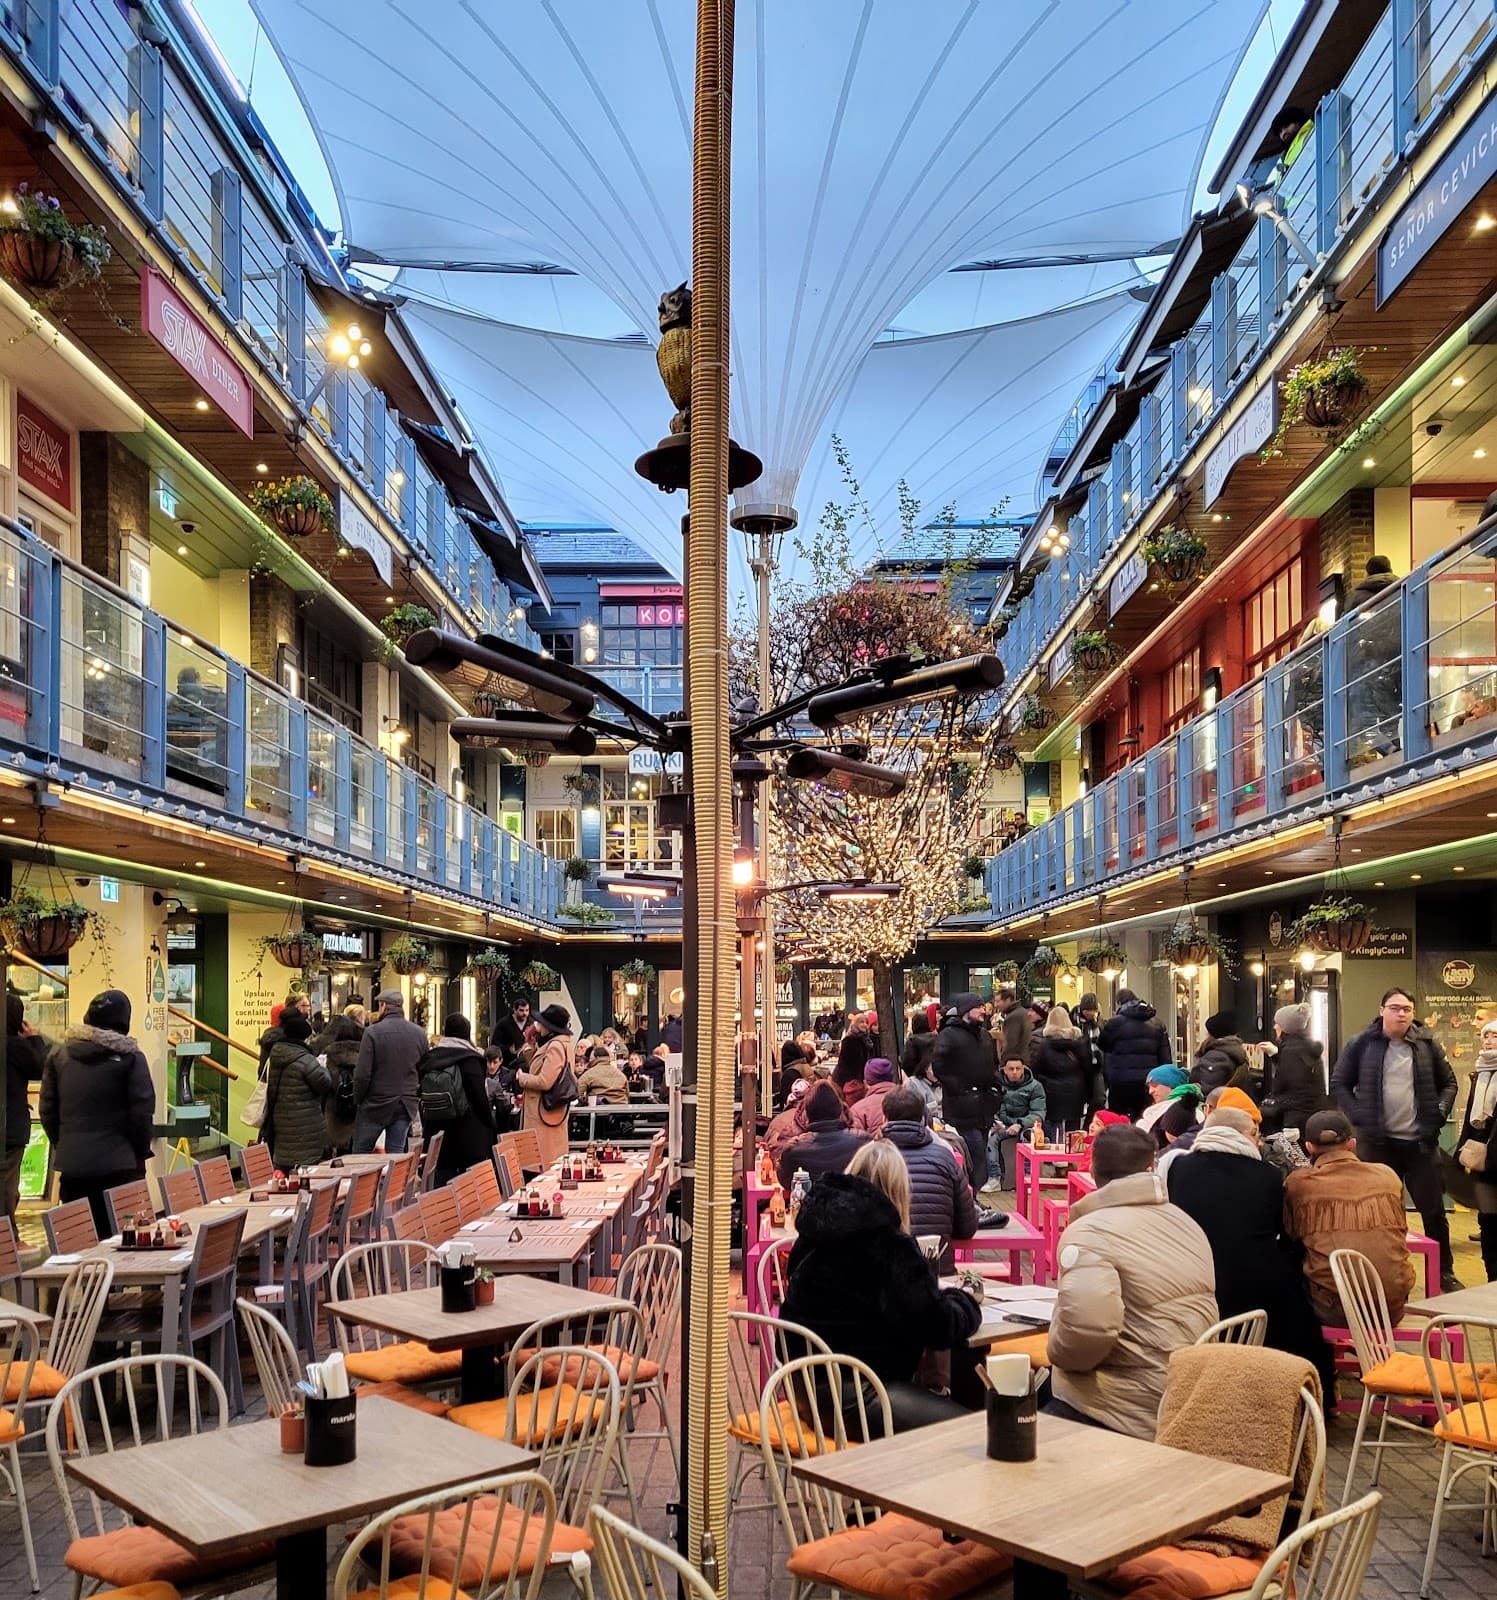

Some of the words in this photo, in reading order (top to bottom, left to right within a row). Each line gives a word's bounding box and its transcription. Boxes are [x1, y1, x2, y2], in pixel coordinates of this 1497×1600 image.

[1390, 200, 1434, 269] SEÑOR
[161, 300, 209, 381] STAX
[211, 357, 239, 402] DINER
[17, 414, 64, 481] STAX
[1228, 420, 1248, 462] LIFT
[1370, 934, 1389, 942] your
[1391, 932, 1408, 940] dish
[244, 989, 275, 998] Upstairs
[152, 1007, 165, 1015] FREE
[152, 1022, 165, 1031] HERE
